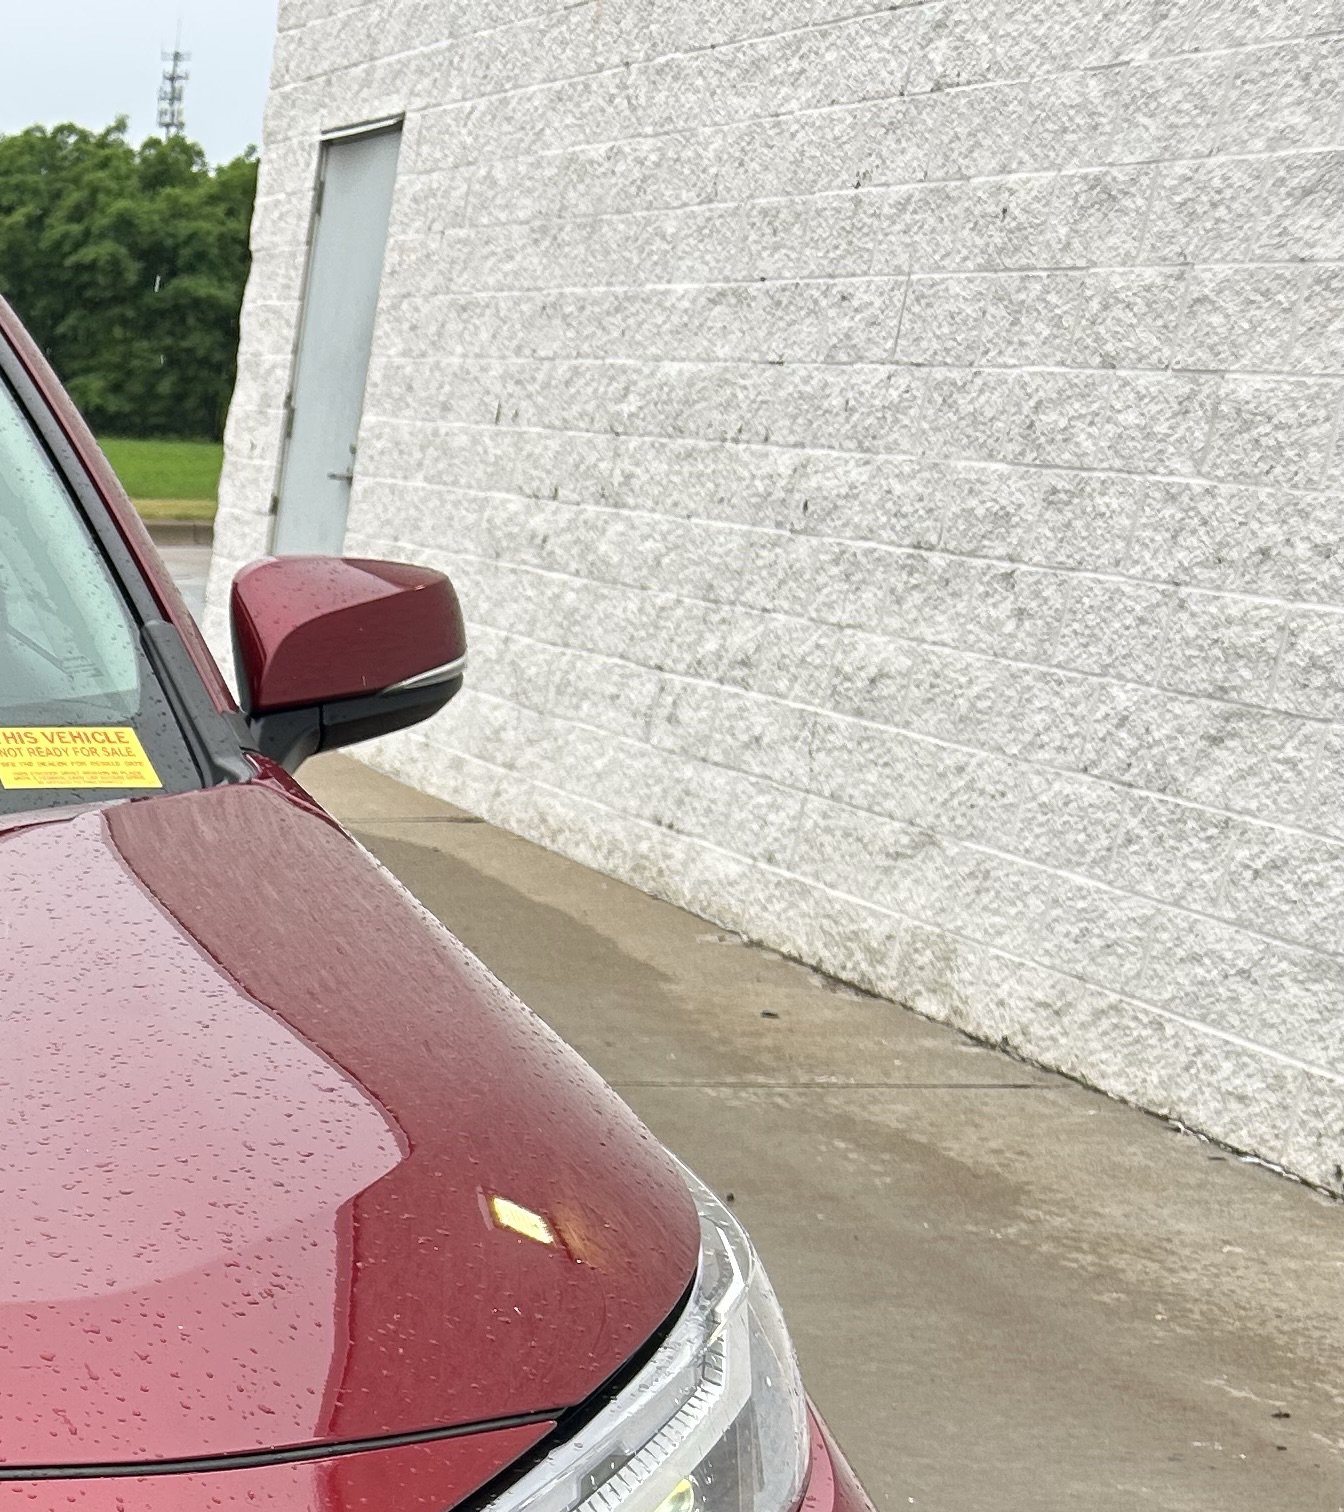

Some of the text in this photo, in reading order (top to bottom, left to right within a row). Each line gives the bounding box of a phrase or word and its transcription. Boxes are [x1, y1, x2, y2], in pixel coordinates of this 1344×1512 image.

[40, 731, 130, 745] VEHICLE
[26, 746, 70, 758] READY
[72, 746, 100, 757] FOR
[101, 746, 136, 757] SALE
